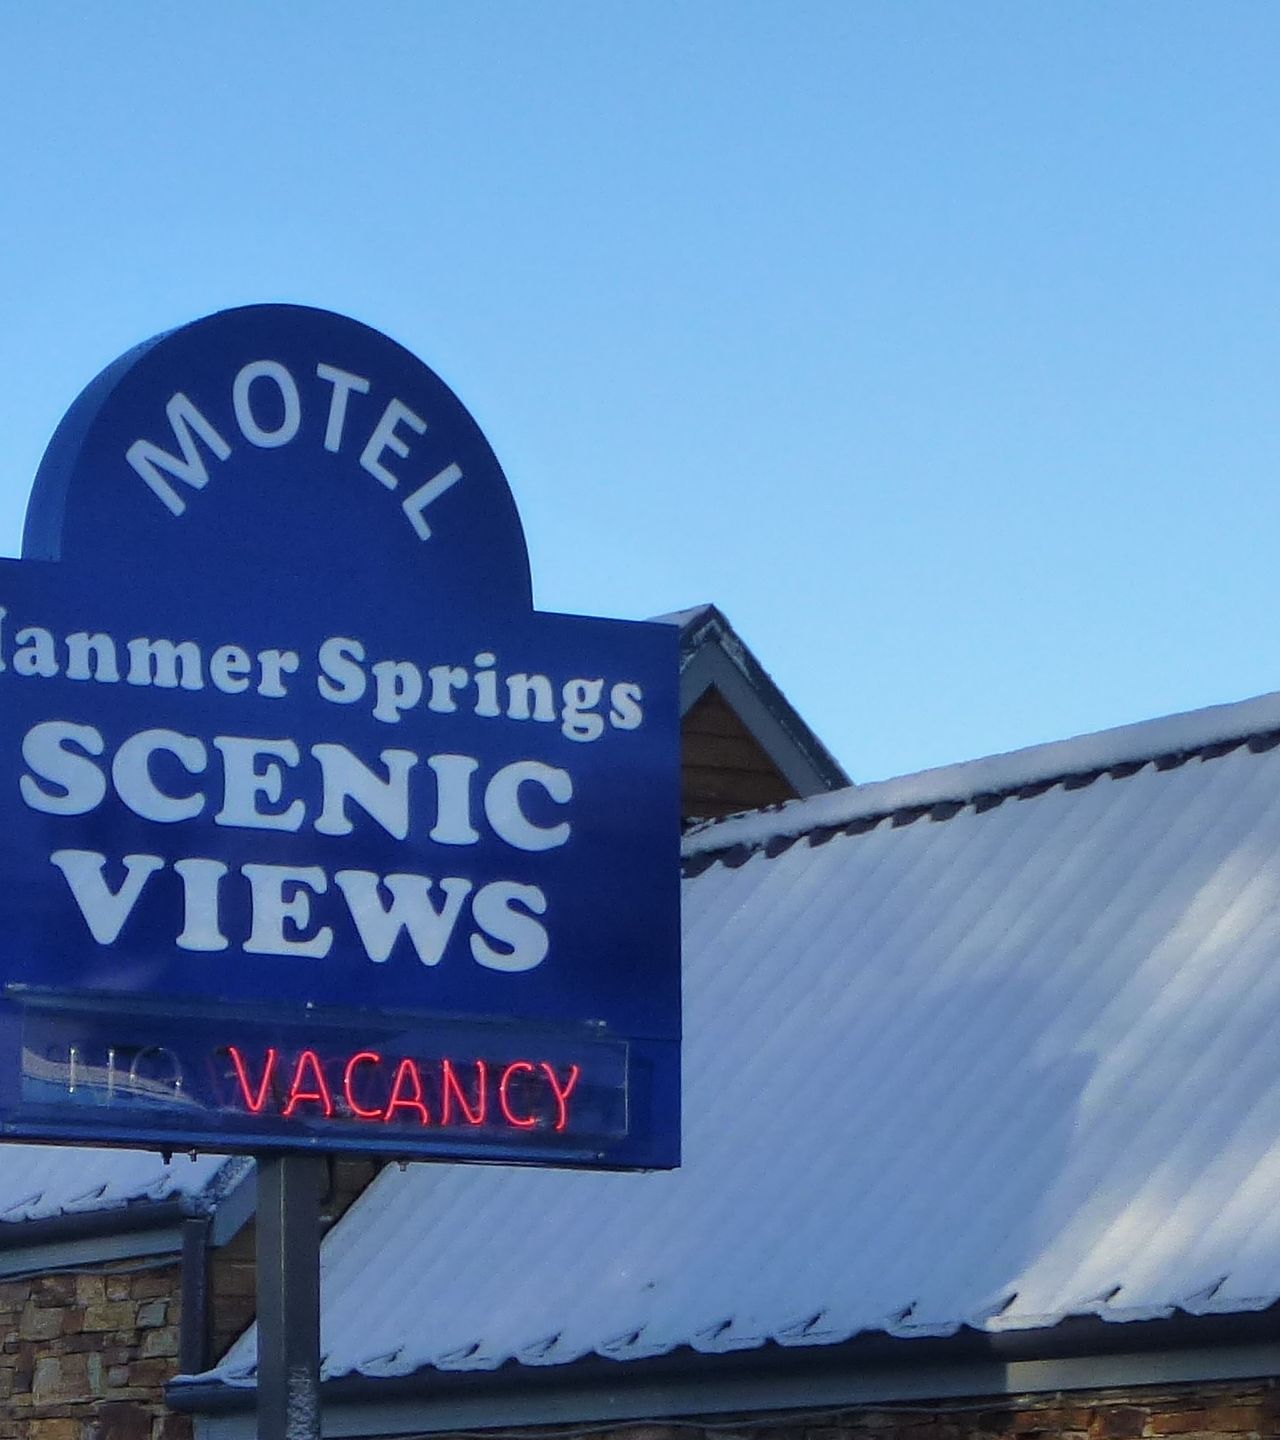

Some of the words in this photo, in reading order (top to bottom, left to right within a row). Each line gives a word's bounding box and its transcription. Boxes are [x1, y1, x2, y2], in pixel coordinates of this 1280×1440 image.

[125, 359, 464, 542] MOTEL
[317, 637, 644, 743] Springs
[18, 720, 574, 853] SCENIC
[49, 848, 551, 974] VIEWS
[228, 1046, 582, 1132] VACANCY
